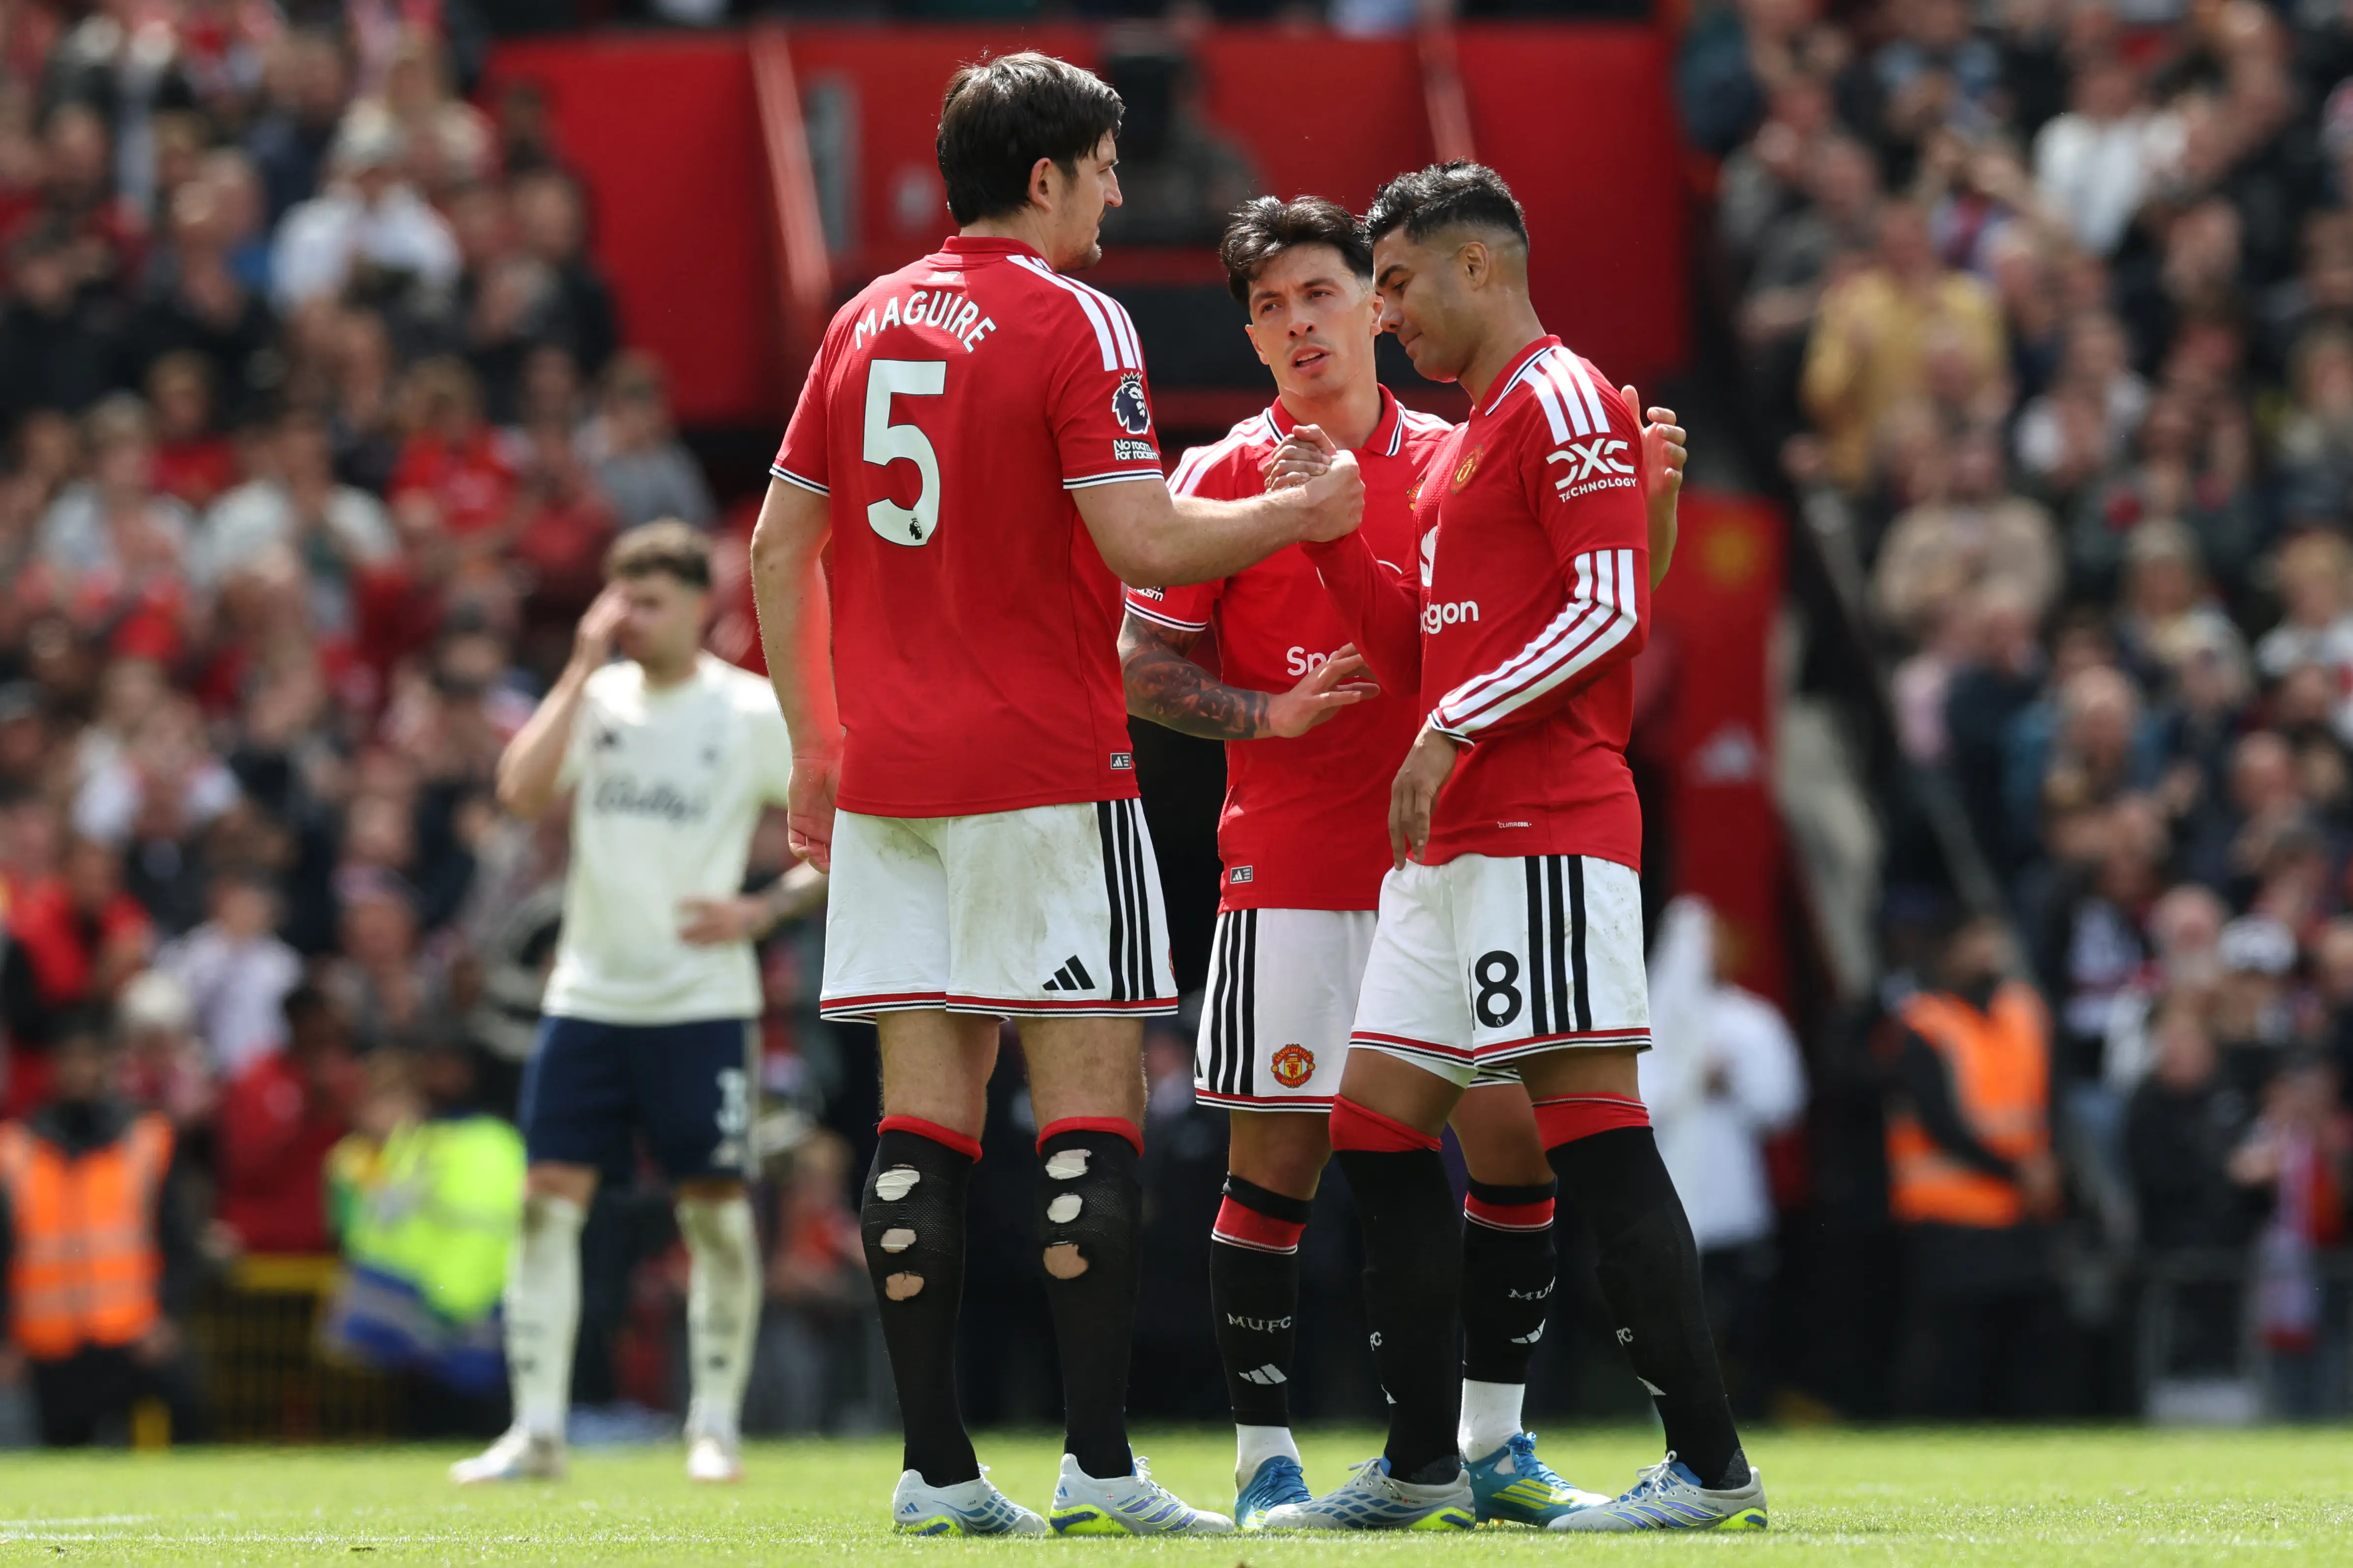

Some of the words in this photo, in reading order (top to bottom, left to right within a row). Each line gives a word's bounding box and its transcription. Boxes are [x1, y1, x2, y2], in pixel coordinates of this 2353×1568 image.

[855, 290, 997, 353] MAGUIRE
[863, 359, 947, 546] 5
[1113, 439, 1131, 450] No
[1131, 441, 1151, 452] room
[1133, 450, 1159, 460] racism
[1546, 438, 1635, 490] DXC
[1559, 478, 1636, 503] TECHNOLOGY
[1275, 1047, 1310, 1062] MANCHESTER
[1508, 1276, 1556, 1301] MU
[1227, 1312, 1292, 1334] MUFC
